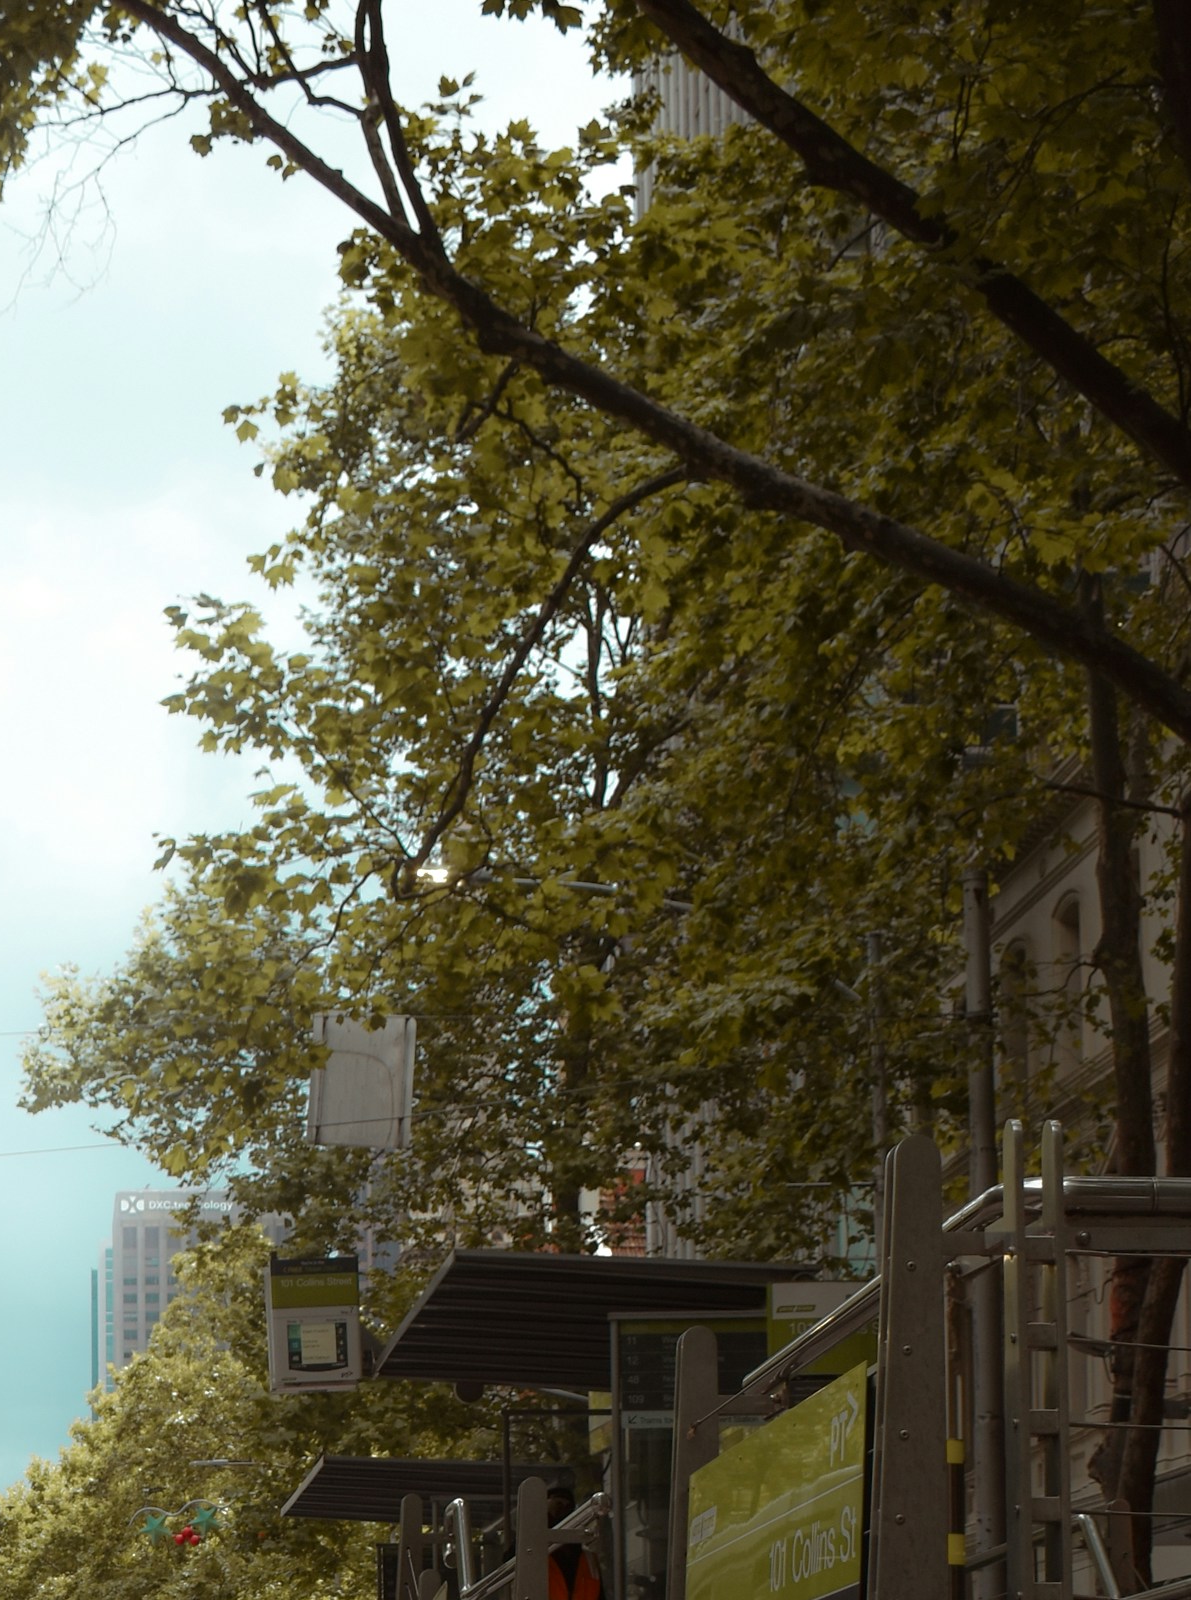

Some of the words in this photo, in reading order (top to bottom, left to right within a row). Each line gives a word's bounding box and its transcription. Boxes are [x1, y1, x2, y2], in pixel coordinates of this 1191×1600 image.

[281, 1278, 294, 1288] 101
[296, 1278, 324, 1287] Collins
[327, 1276, 352, 1286] Street
[628, 1395, 644, 1404] 109
[769, 1537, 787, 1592] 101
[792, 1520, 836, 1584] Collins
[840, 1506, 856, 1562] St
